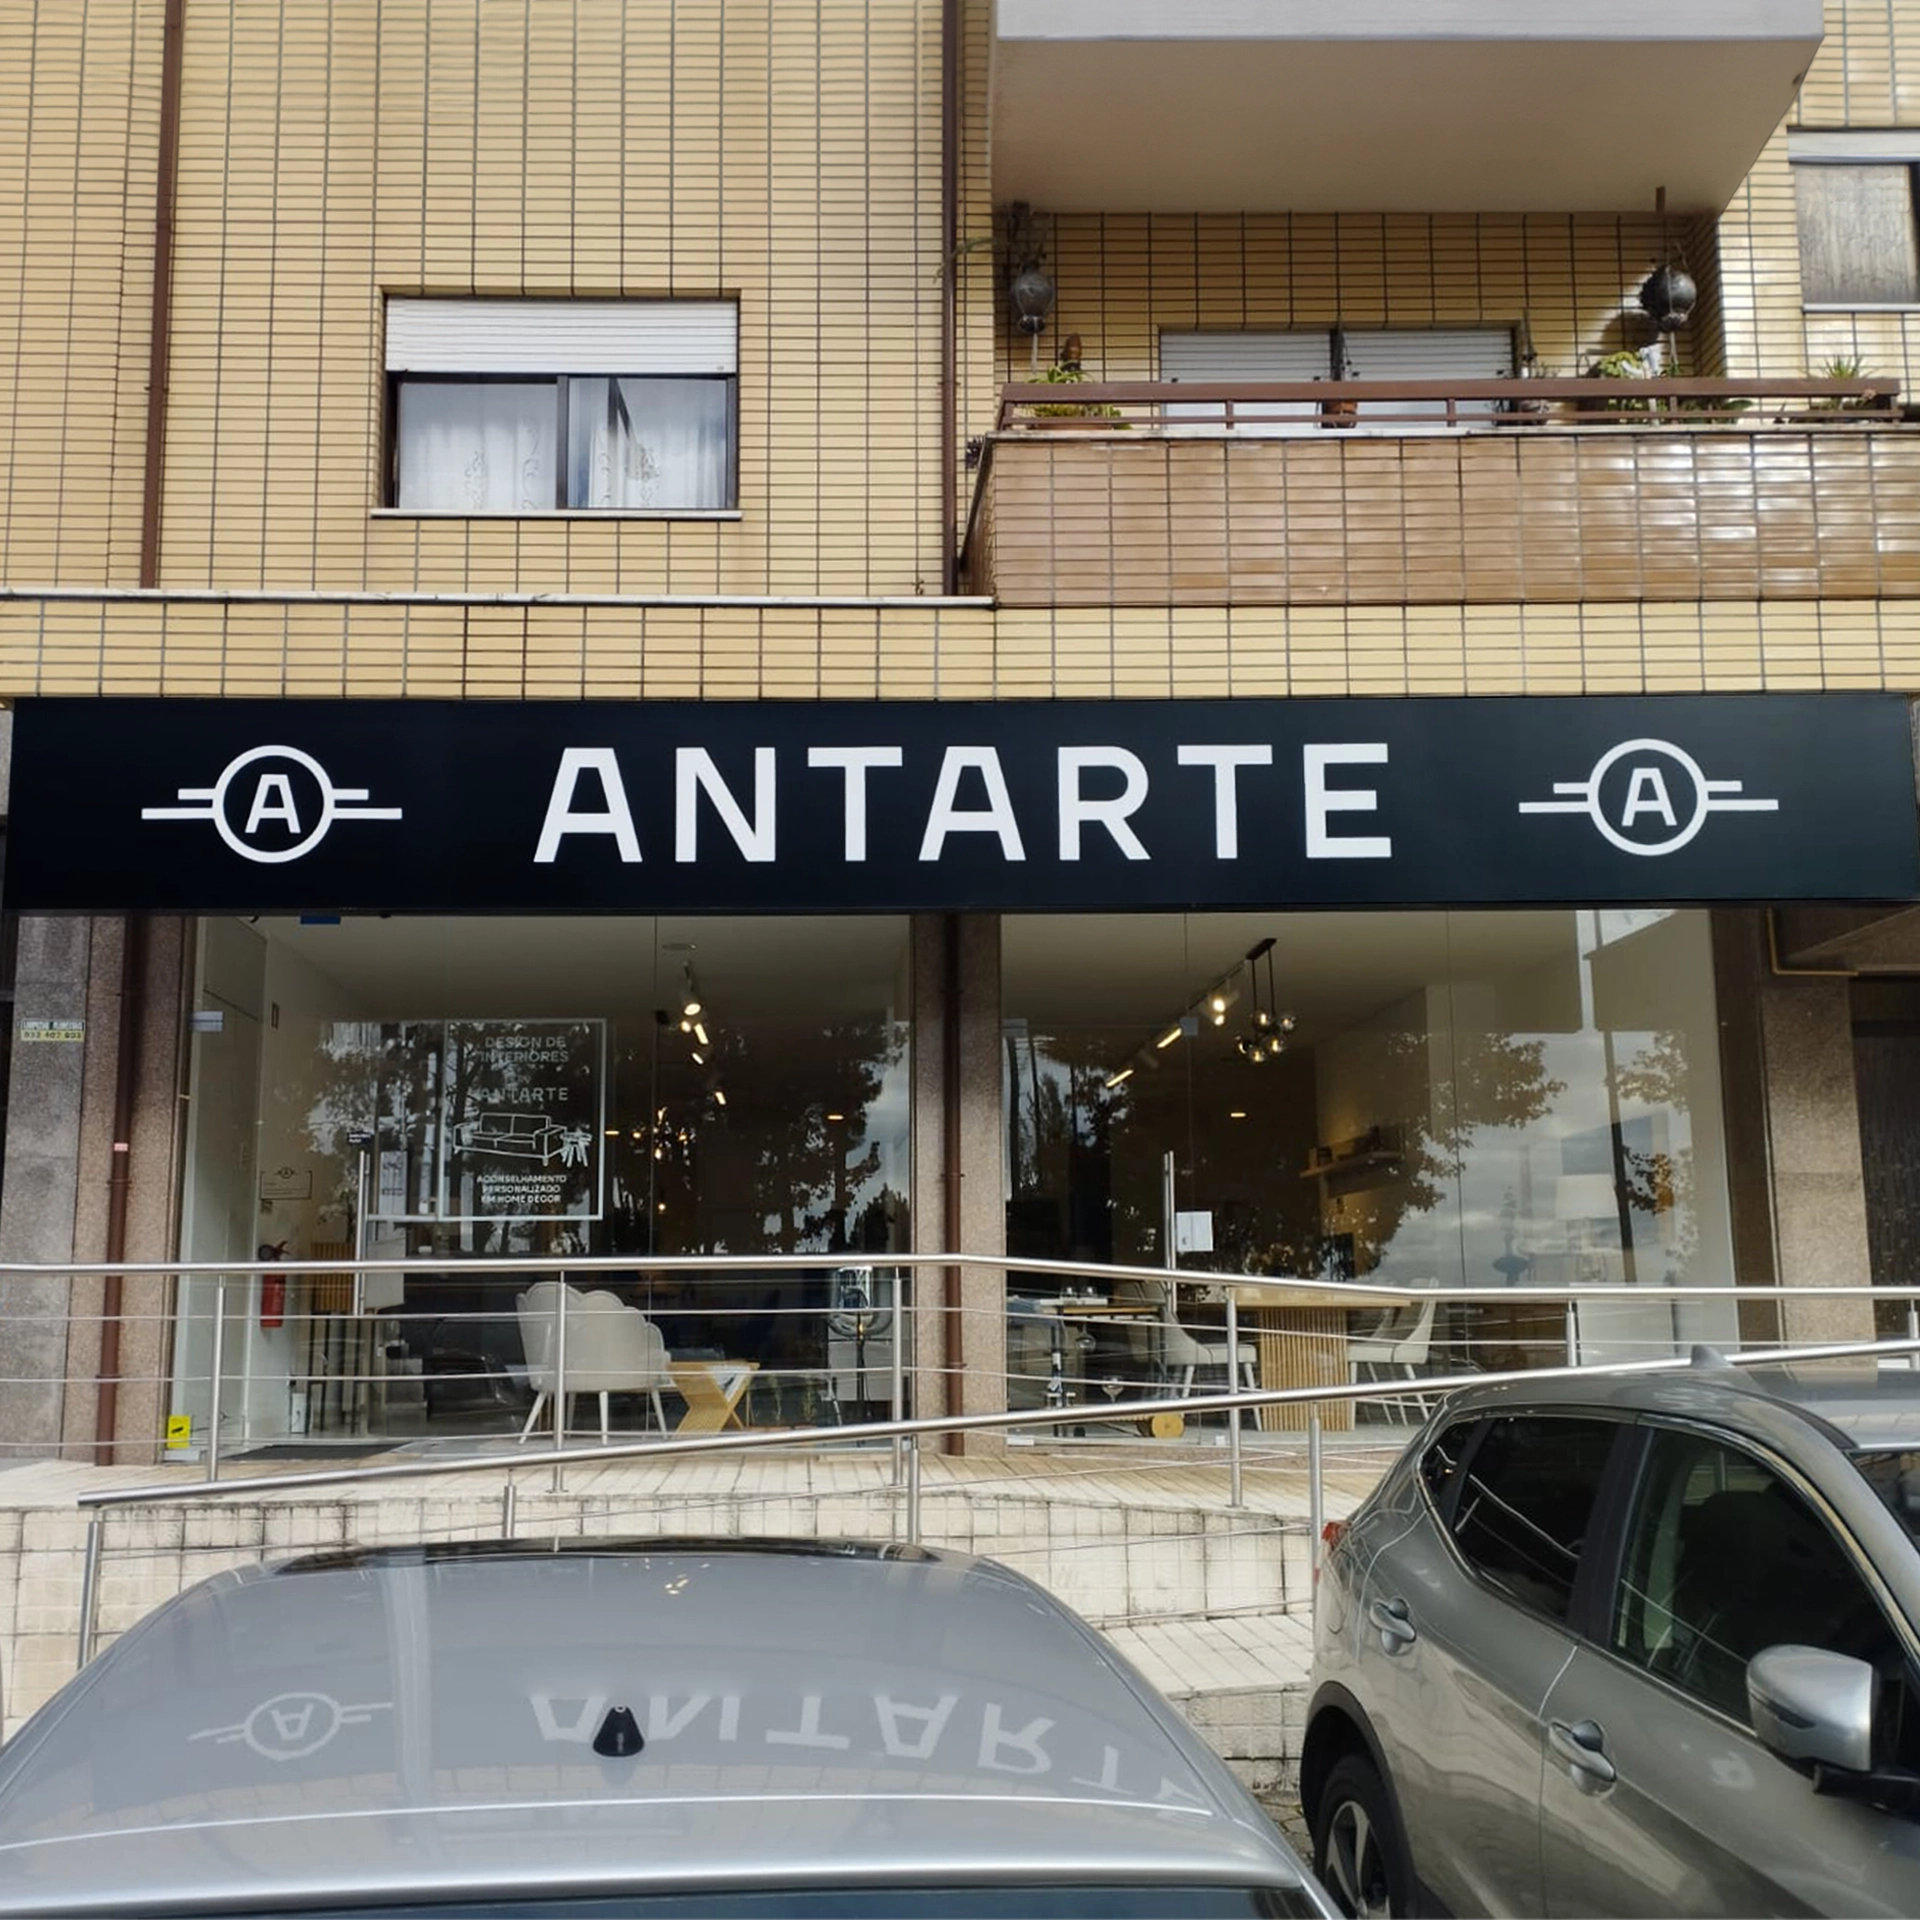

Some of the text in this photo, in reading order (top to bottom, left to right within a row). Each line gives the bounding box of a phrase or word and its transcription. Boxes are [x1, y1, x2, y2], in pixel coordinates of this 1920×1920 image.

[246, 774, 301, 834] A
[533, 743, 1392, 863] ANTARTE
[1621, 767, 1678, 827] A
[485, 1036, 567, 1048] DESIGN DE
[480, 1050, 569, 1062] INTERIORES
[479, 1087, 569, 1101] ANTARTE
[482, 1184, 561, 1194] PERSONALIZADO
